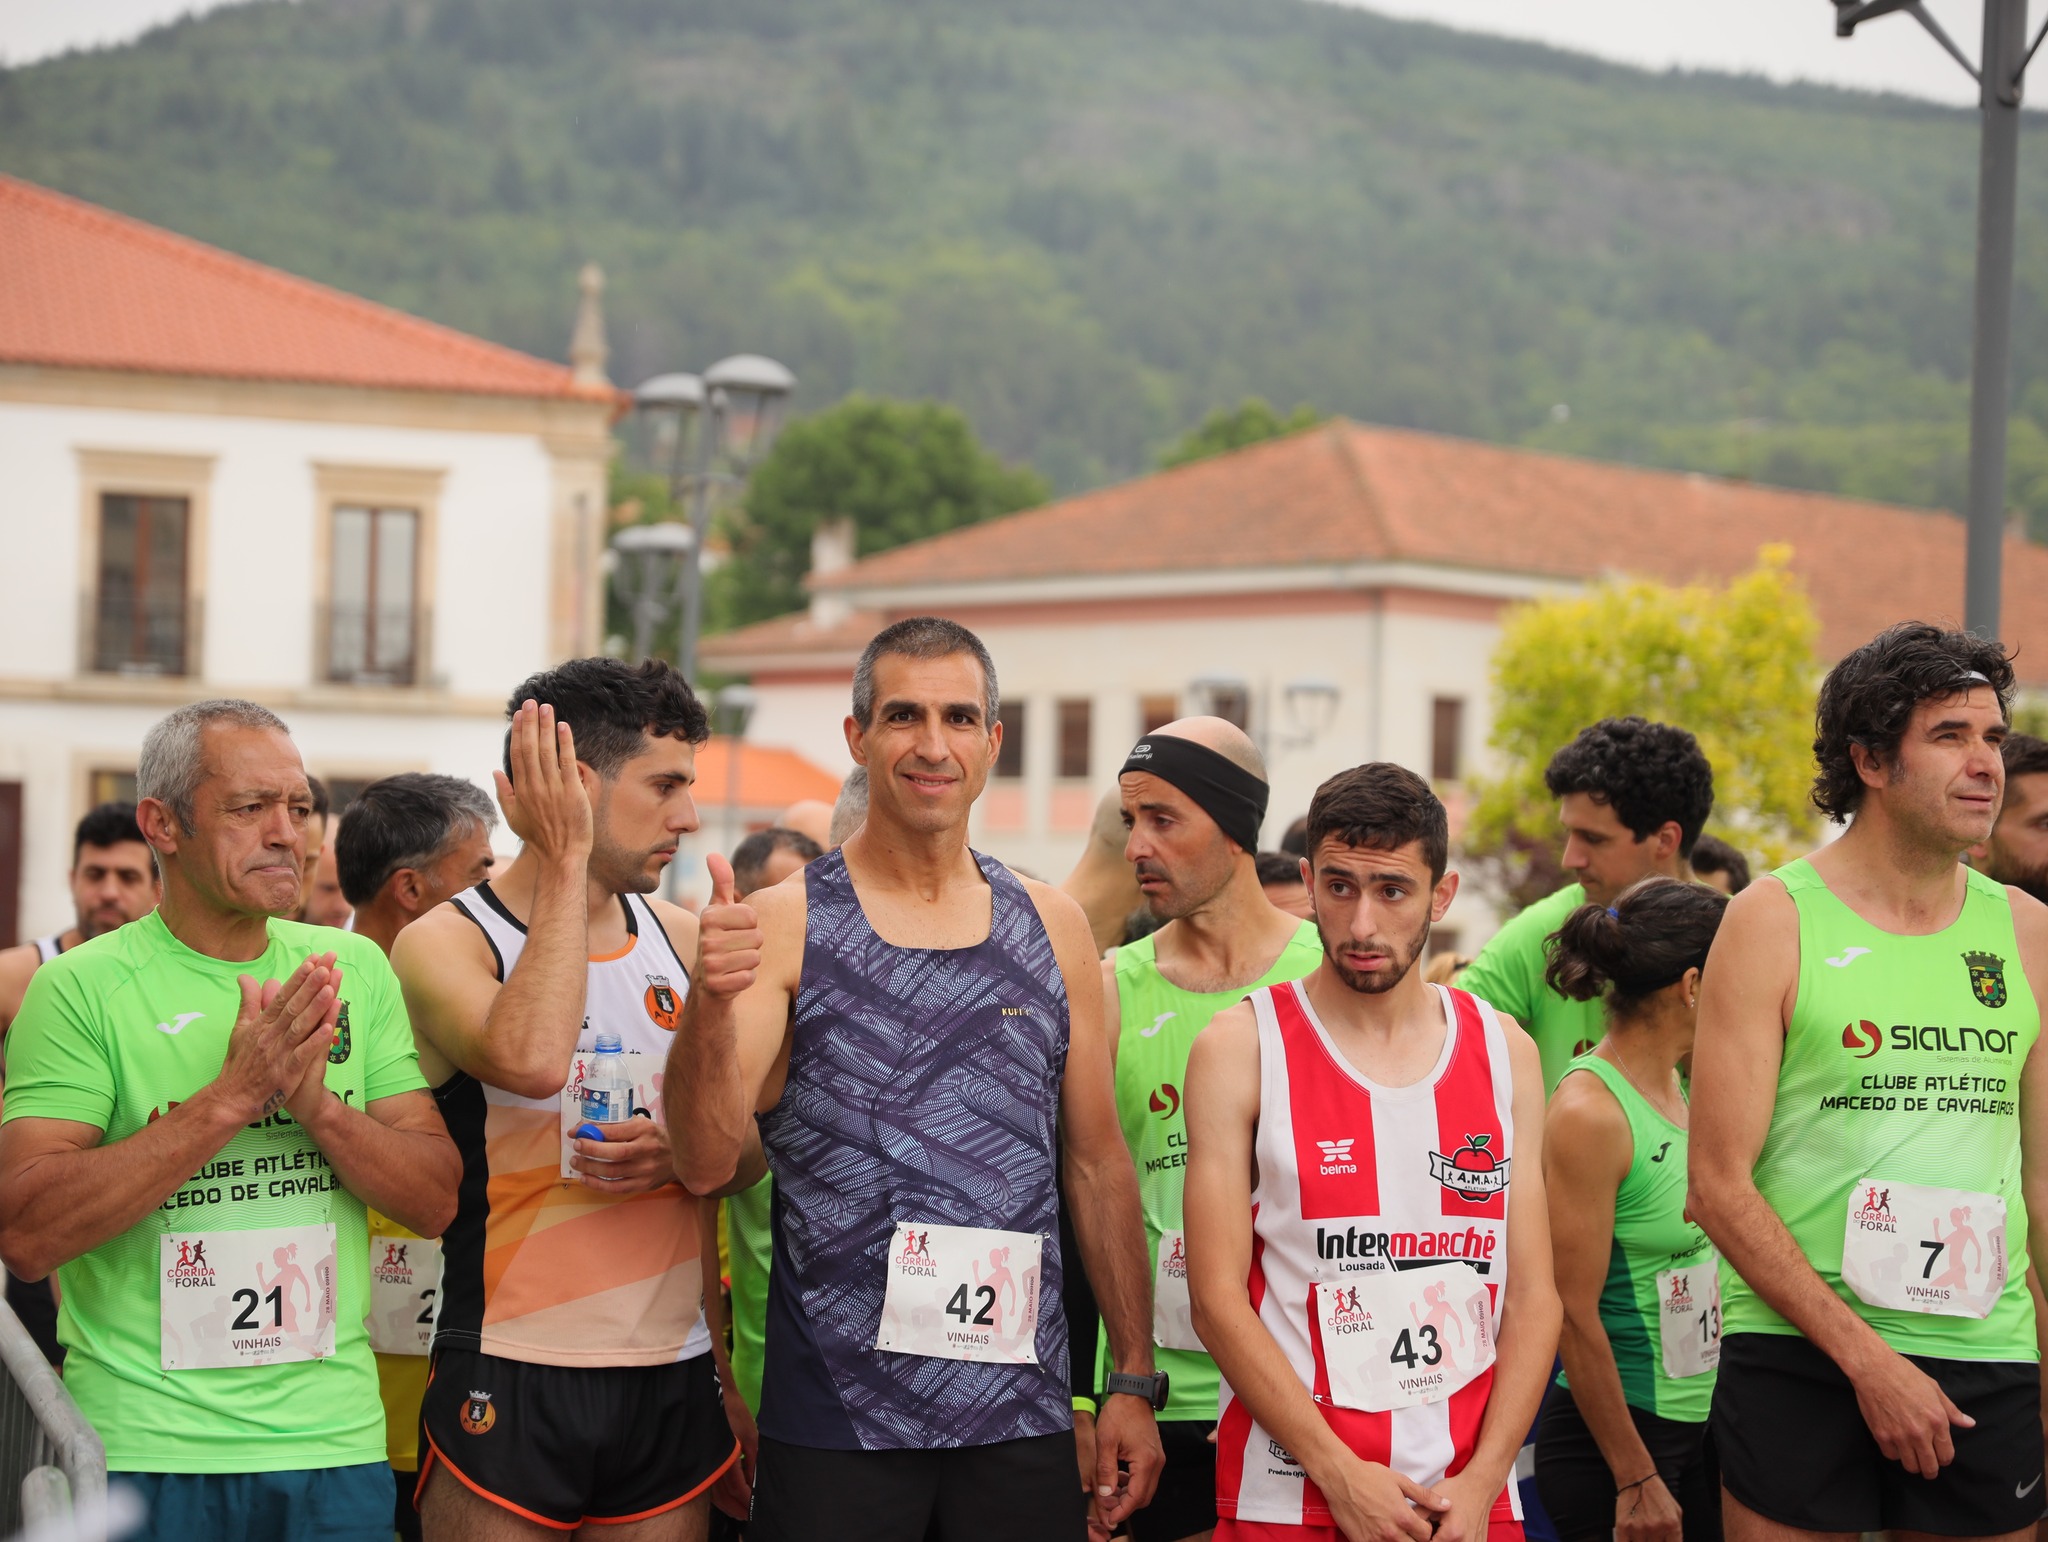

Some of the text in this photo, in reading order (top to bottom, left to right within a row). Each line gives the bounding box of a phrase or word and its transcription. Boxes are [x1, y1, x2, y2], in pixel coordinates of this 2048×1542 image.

[1860, 1073, 2007, 1093] CLUBE ATLÉTICO
[1819, 1096, 2015, 1116] MACEDO DE CAVALEIROS
[254, 1148, 331, 1177] ATLÉTI
[1319, 1163, 1357, 1176] belma
[159, 1187, 222, 1211] CEDO
[231, 1183, 260, 1202] DE
[1853, 1211, 1897, 1224] CORRIDA
[1860, 1221, 1897, 1234] FORAL
[895, 1255, 937, 1267] CORRIDA
[1163, 1260, 1186, 1269] CORR
[1338, 1260, 1386, 1273] Lousada
[1920, 1240, 1945, 1279] 7
[166, 1267, 216, 1279] CORRIDA
[374, 1266, 413, 1276] CORRIDA
[902, 1265, 938, 1277] FORAL
[1167, 1268, 1187, 1279] FOR
[175, 1277, 216, 1288] FORAL
[379, 1274, 413, 1285] FORAL
[1905, 1285, 1951, 1300] VINHAIS
[231, 1285, 283, 1331] 21
[416, 1288, 437, 1325] 2
[945, 1283, 997, 1326] 42
[1670, 1304, 1694, 1315] FORAL
[1327, 1311, 1373, 1327] CORRIDA
[1336, 1321, 1375, 1336] FORAL
[231, 1336, 282, 1350] VINHAIS
[946, 1331, 990, 1345] VINHAIS
[1389, 1324, 1444, 1370] 43
[1398, 1373, 1444, 1391] VINHAIS
